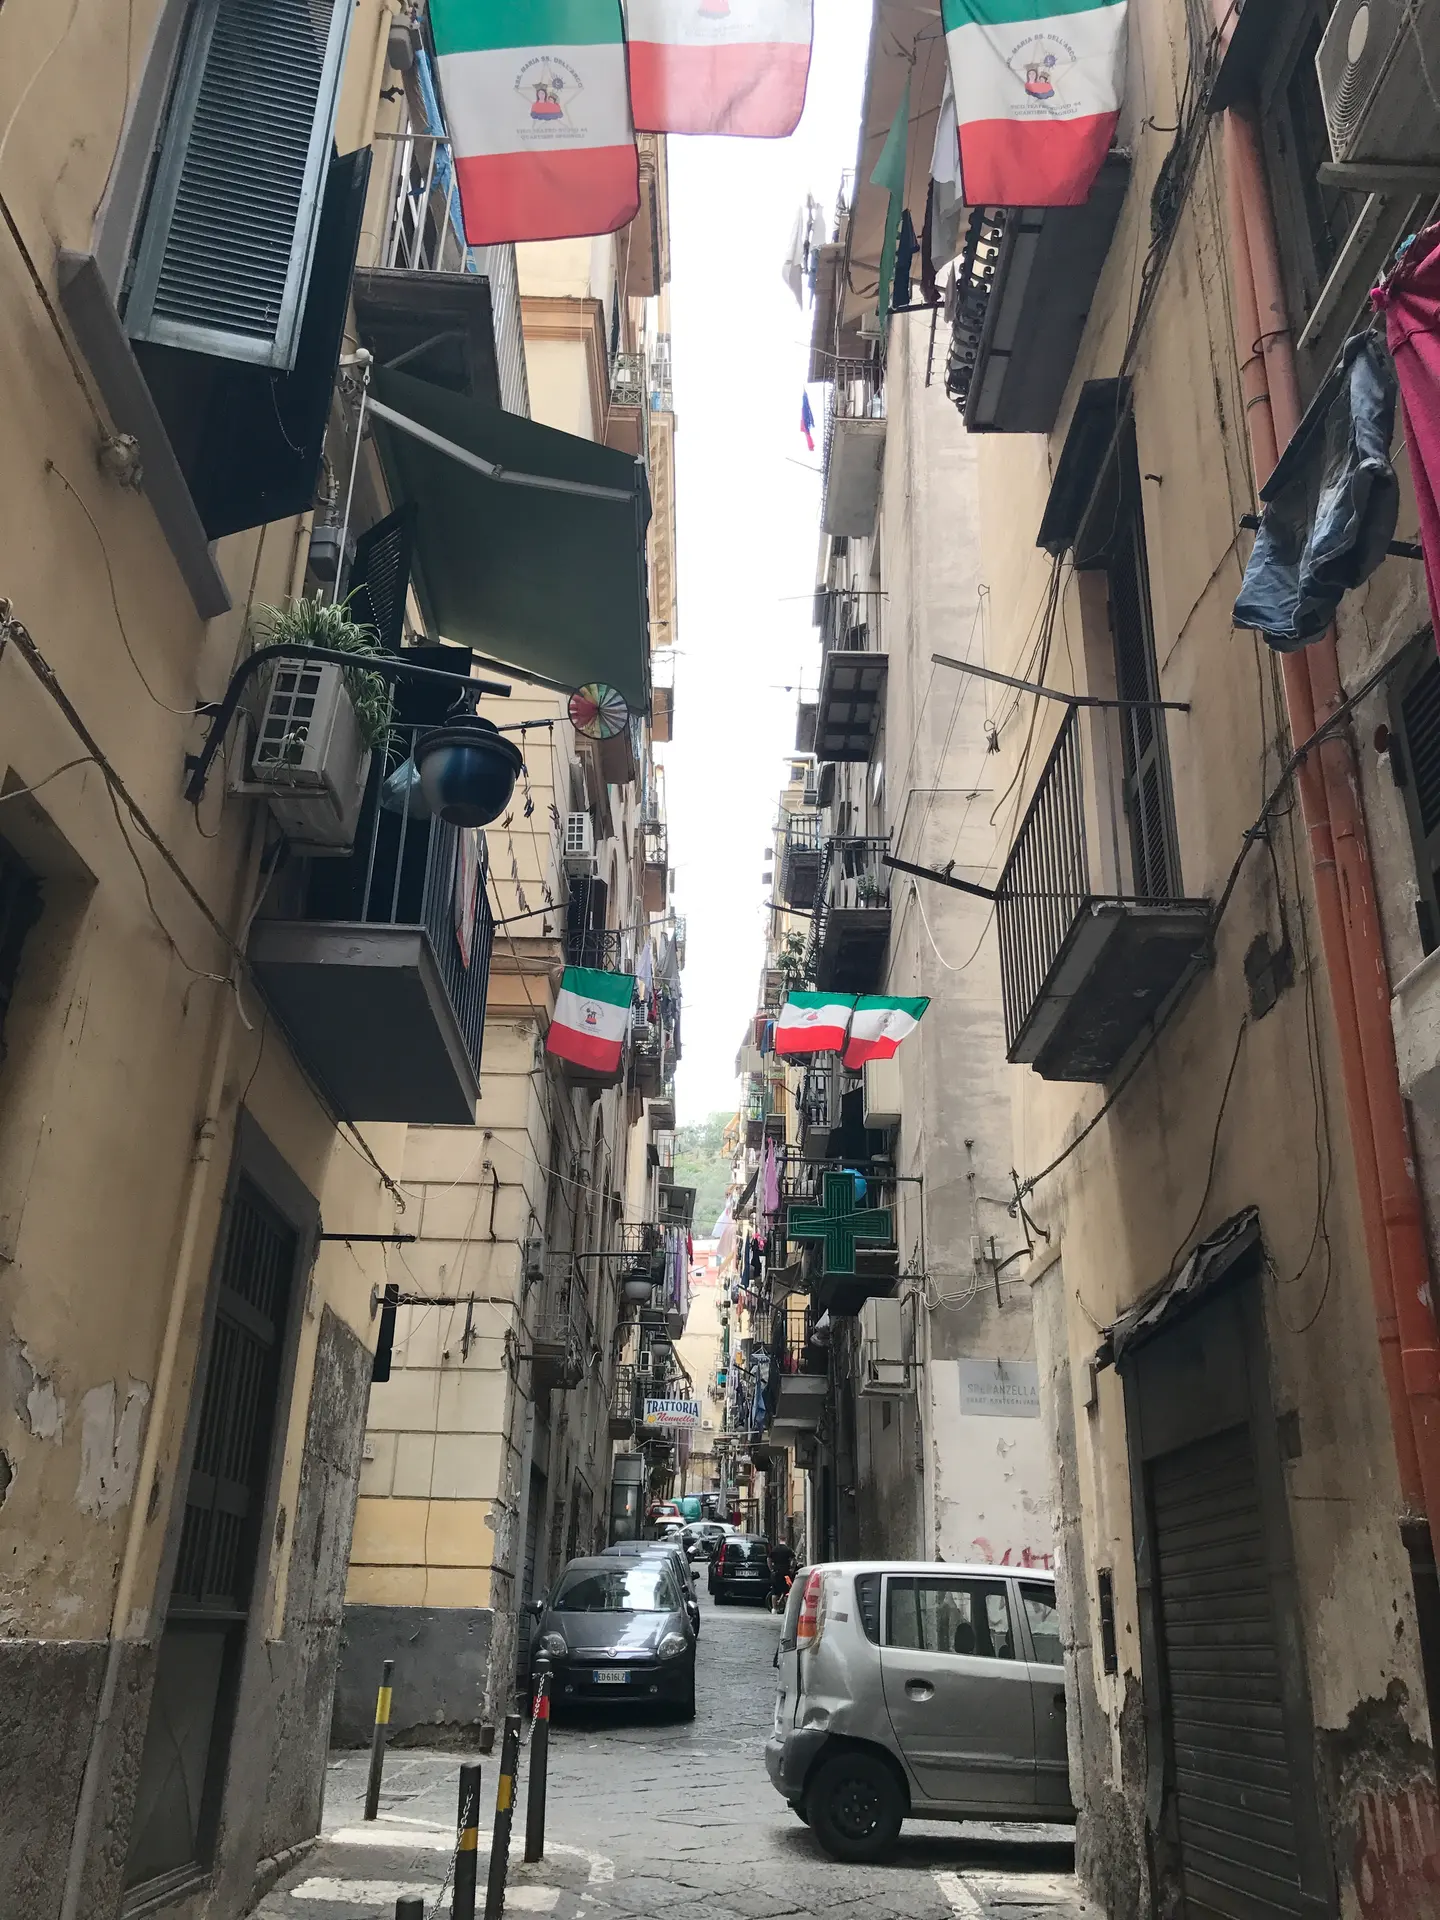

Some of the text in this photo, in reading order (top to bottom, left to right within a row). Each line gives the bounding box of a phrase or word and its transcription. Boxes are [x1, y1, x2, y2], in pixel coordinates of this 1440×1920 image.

[1012, 37, 1033, 54] MARIA
[1047, 34, 1077, 63] DELL'ARCO
[521, 57, 540, 73] MARIA
[994, 1371, 1010, 1381] VIA
[646, 1400, 699, 1418] TRATTORIA
[656, 1412, 696, 1423] Nennella
